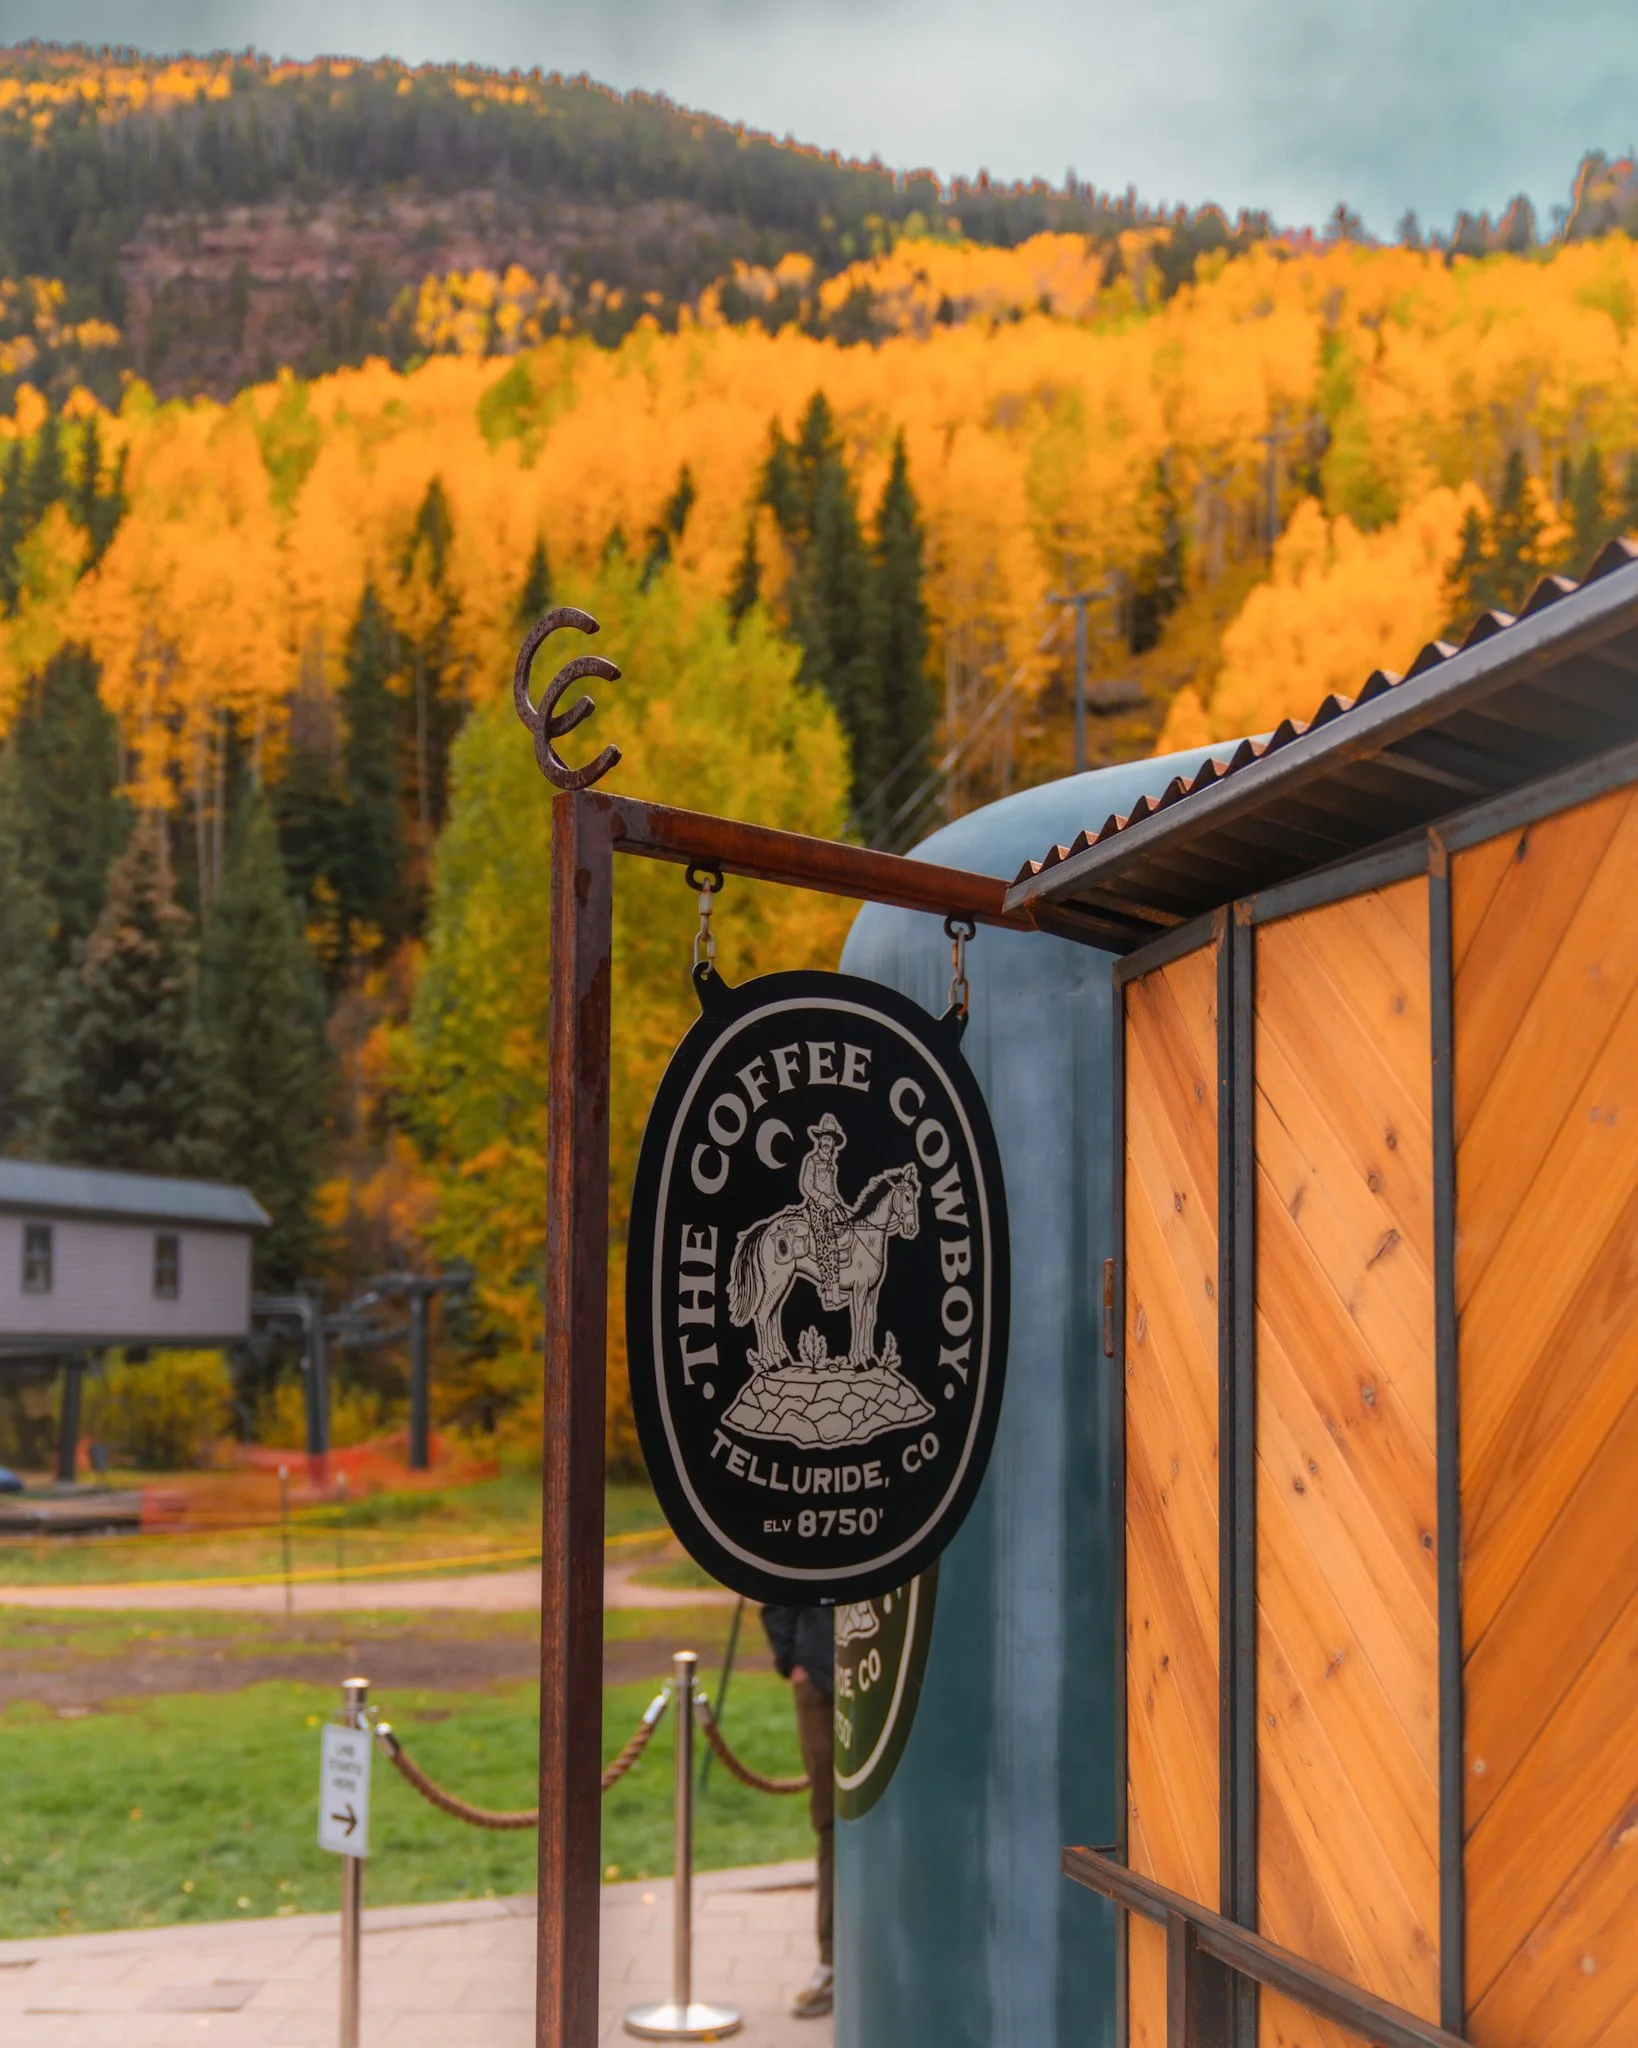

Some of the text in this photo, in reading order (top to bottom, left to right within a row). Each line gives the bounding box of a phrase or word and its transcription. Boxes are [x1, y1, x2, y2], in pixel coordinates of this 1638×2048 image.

[678, 1040, 974, 1386] THE COFFEE COWBOY
[709, 1428, 941, 1495] TELLURIDE, CO
[763, 1507, 884, 1538] ELV 8750'
[858, 1647, 881, 1692] CO
